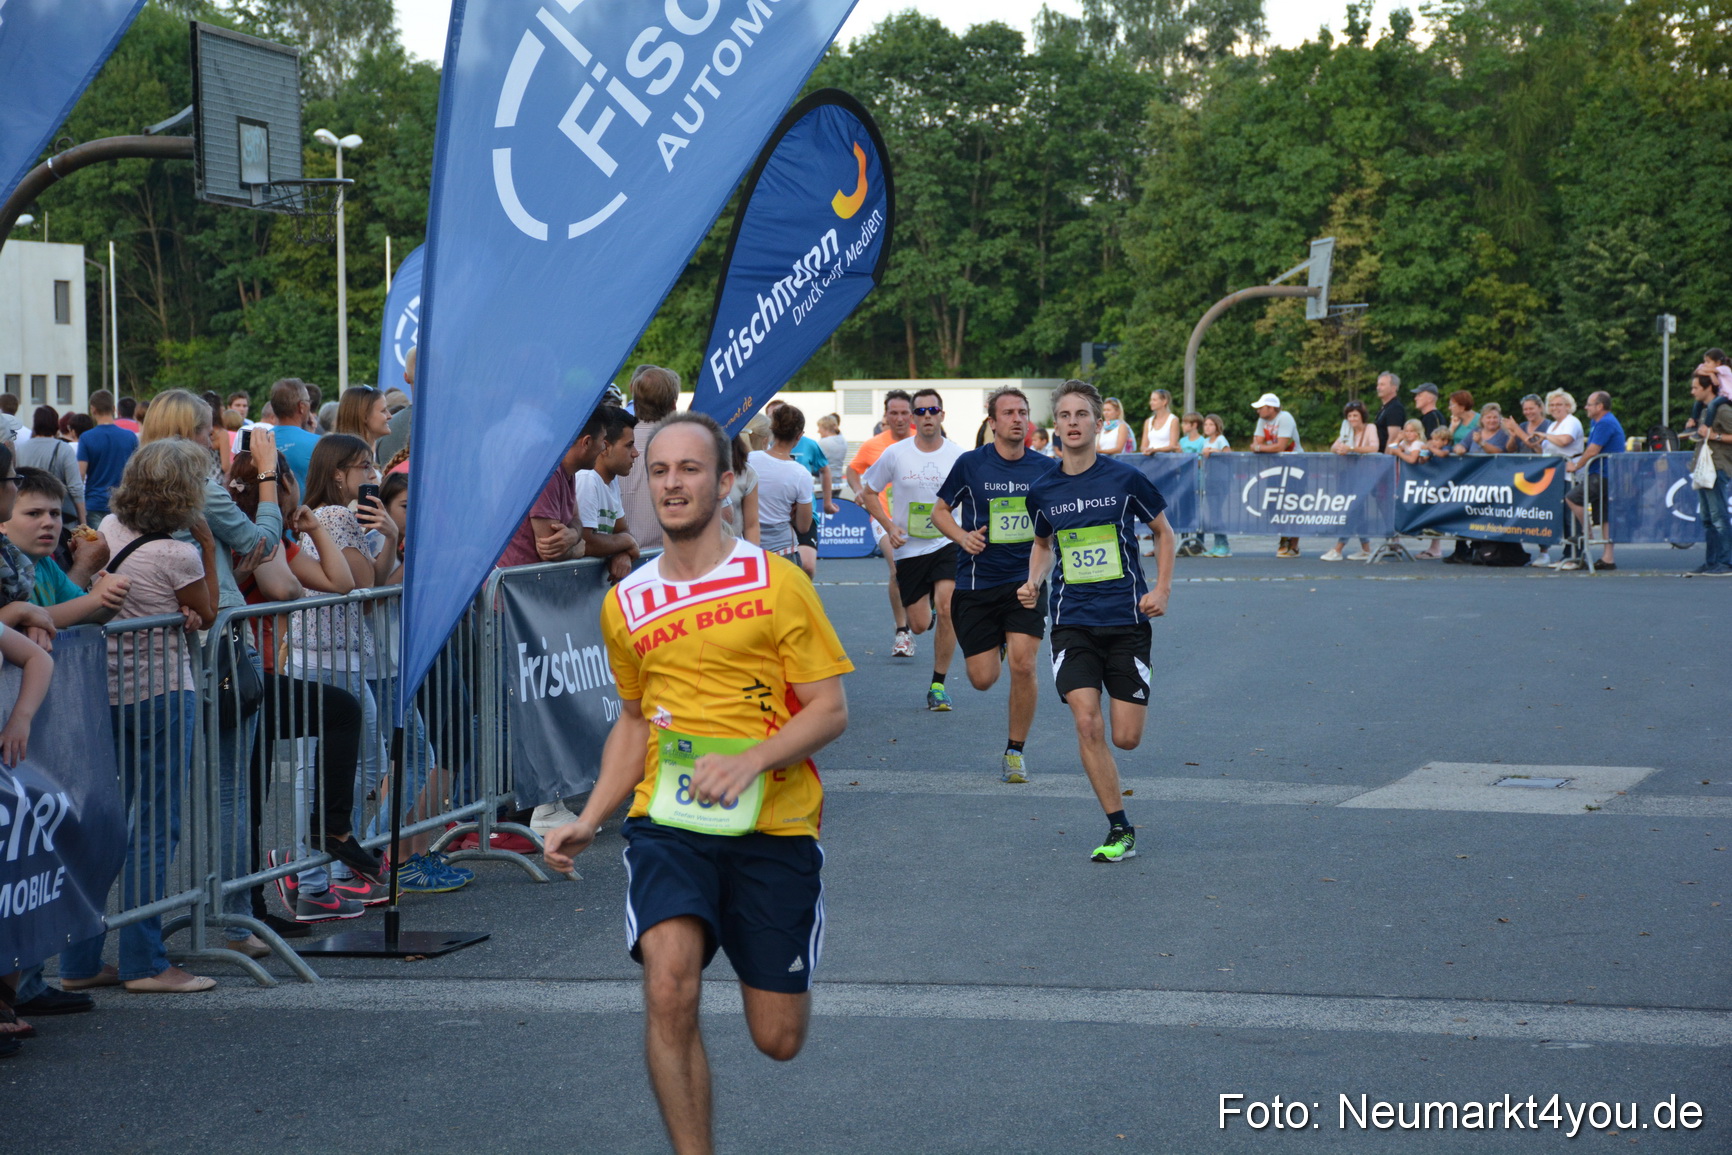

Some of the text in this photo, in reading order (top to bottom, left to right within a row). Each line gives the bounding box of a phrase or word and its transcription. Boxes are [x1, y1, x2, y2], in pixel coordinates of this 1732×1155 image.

[657, 0, 782, 173] AUTOM
[792, 281, 824, 326] Druck
[845, 209, 883, 267] Medien
[710, 228, 839, 394] Frischmann
[984, 482, 1008, 491] EURO
[1402, 480, 1513, 504] Frischmann
[1050, 496, 1117, 516] EURO POLES
[1262, 487, 1356, 512] Fischer
[1000, 515, 1030, 531] 370
[1270, 514, 1347, 525] AUTOMOBILE
[1464, 504, 1553, 520] Druck und Medien
[1071, 547, 1108, 568] 352
[633, 599, 773, 660] MAX BÖGL
